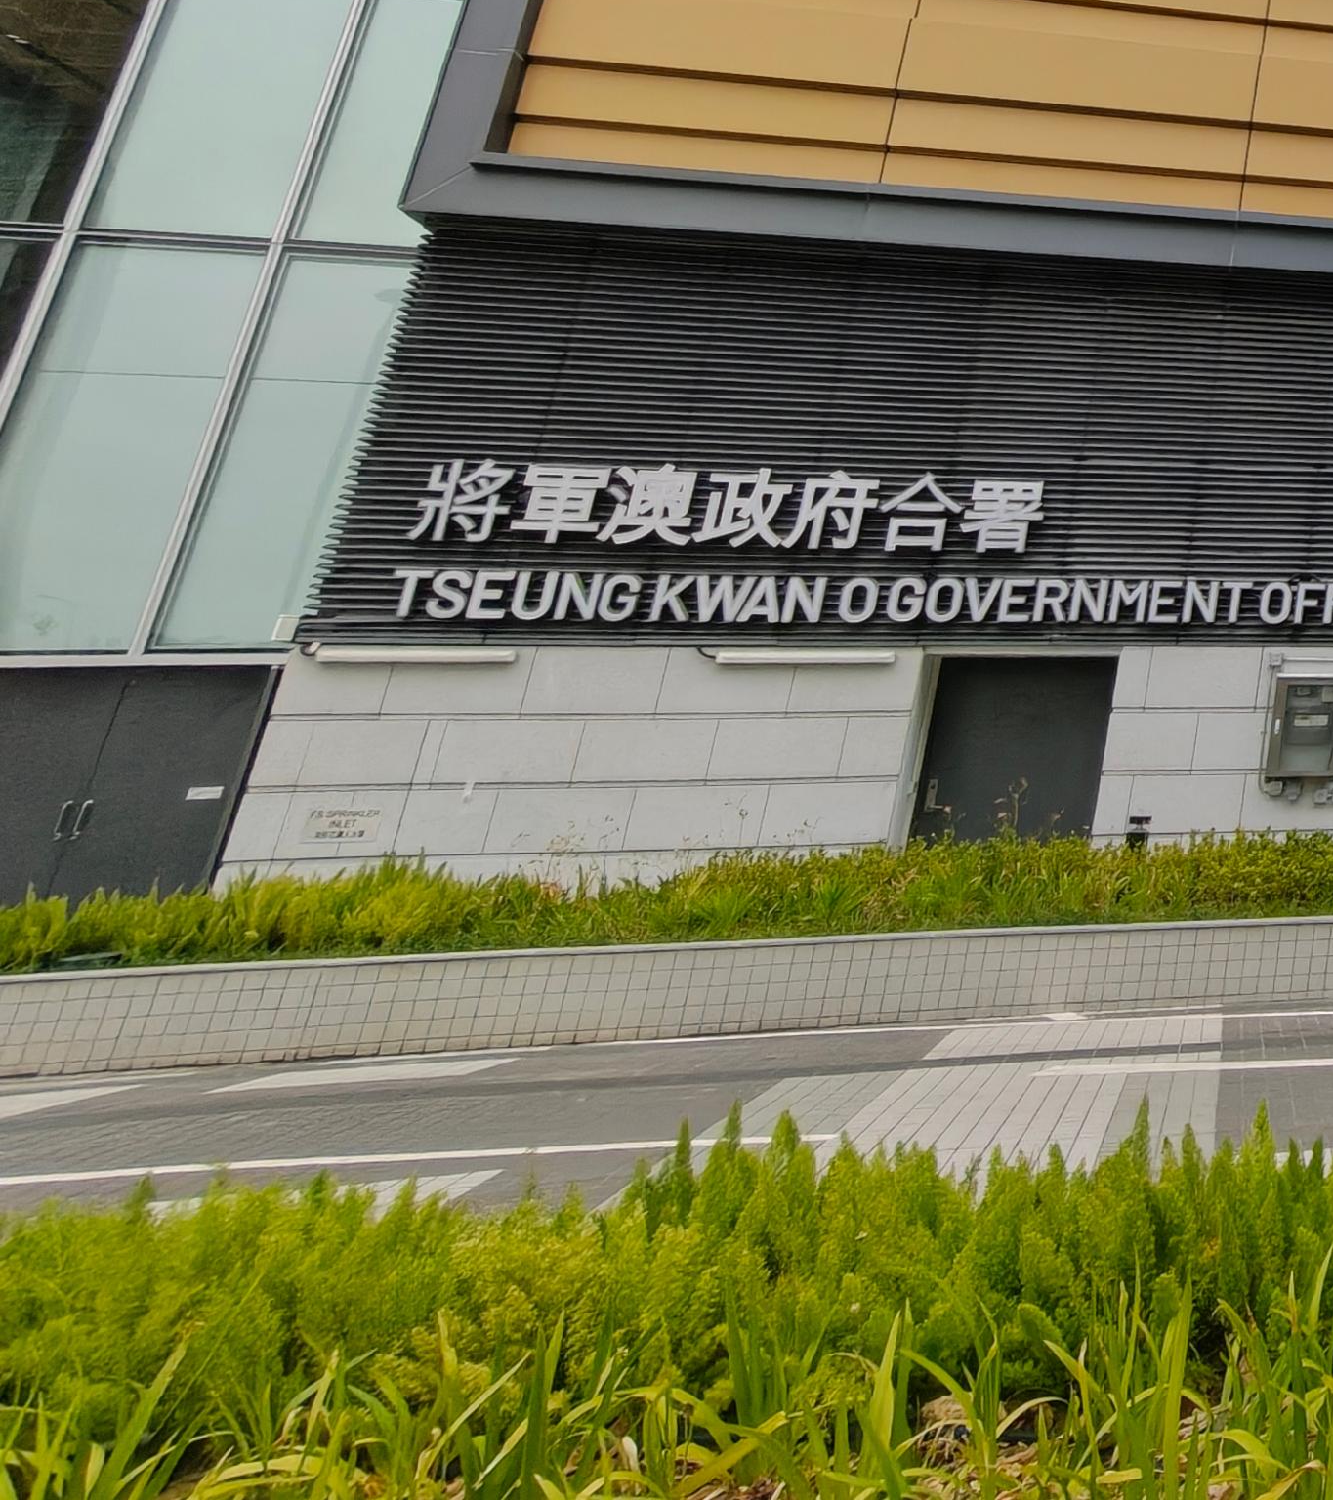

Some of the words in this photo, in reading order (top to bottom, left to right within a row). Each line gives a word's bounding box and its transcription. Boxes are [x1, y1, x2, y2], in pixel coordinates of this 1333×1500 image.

[406, 458, 1045, 553] 將軍澳政府合署
[394, 568, 644, 622] TSEUNG
[650, 573, 828, 622] KWAN
[837, 576, 877, 622] O
[882, 576, 1254, 623] GOVERNMENT
